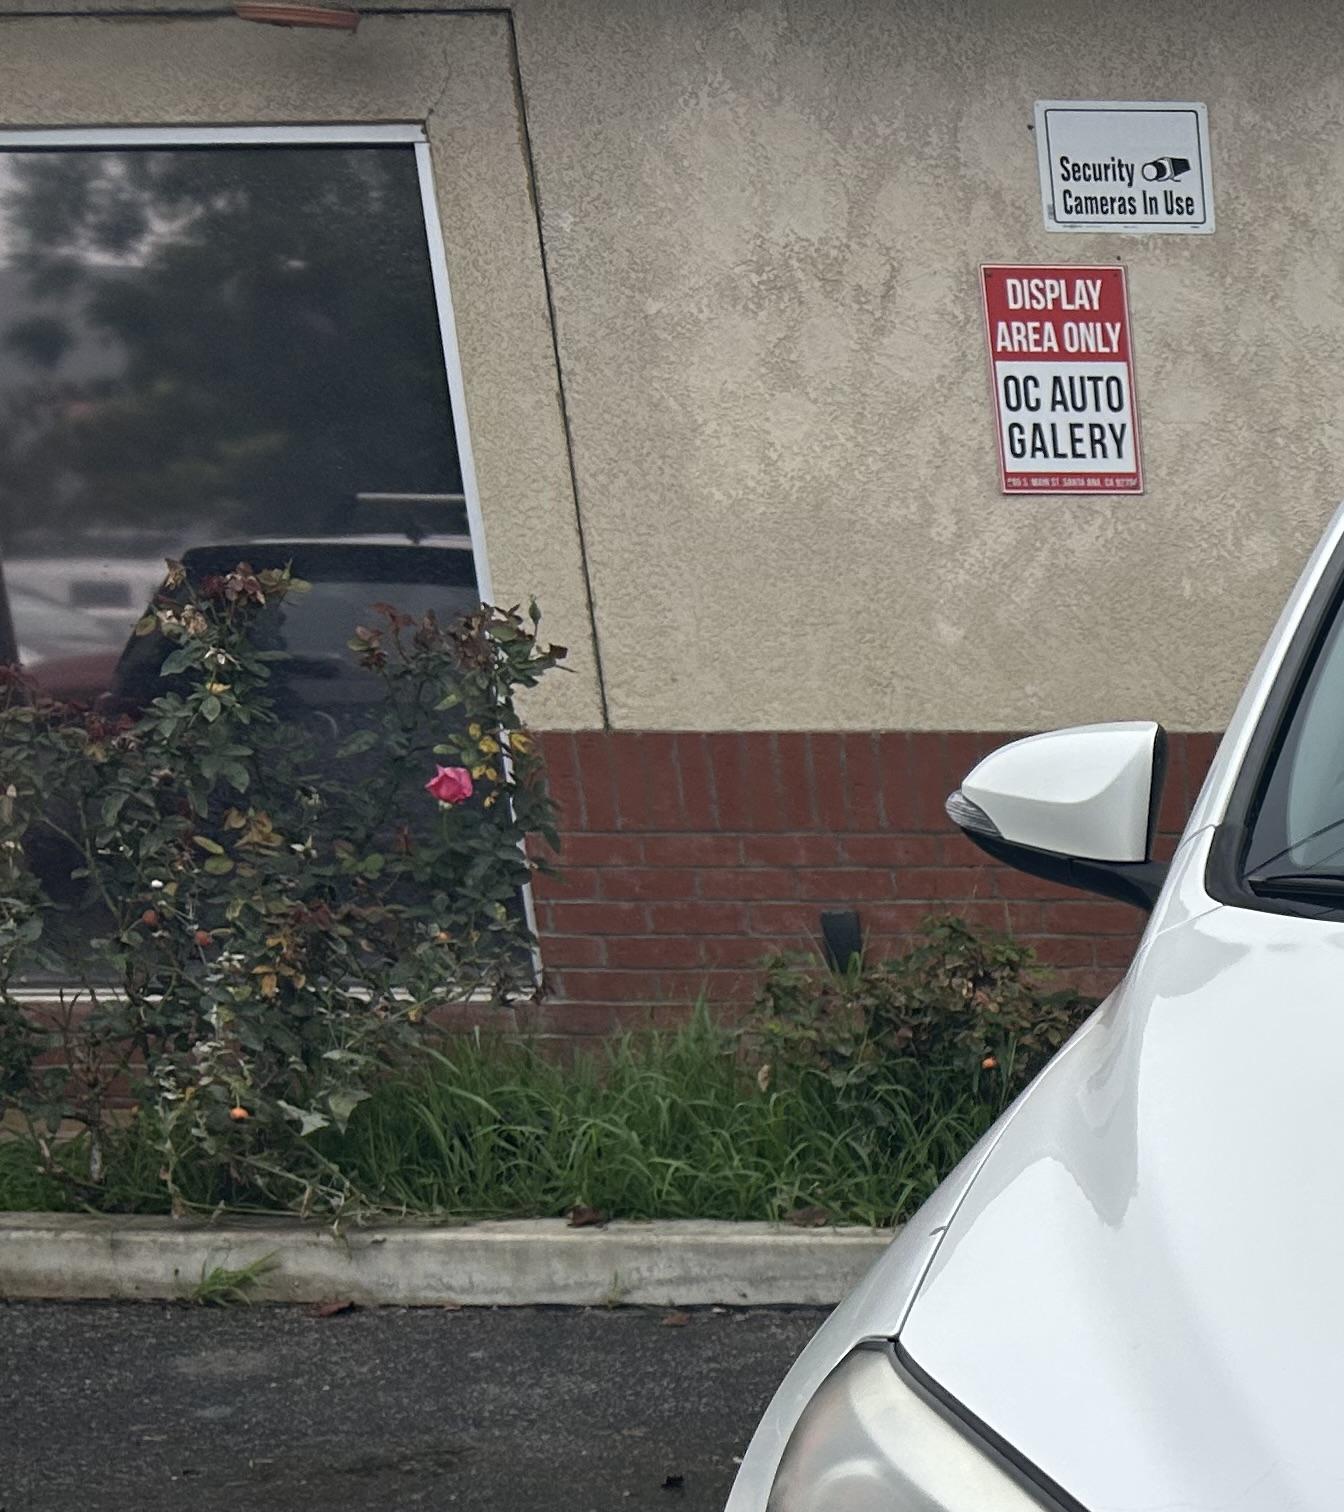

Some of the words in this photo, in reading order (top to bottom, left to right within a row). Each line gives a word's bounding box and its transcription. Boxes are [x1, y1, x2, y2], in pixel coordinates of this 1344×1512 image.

[1060, 155, 1134, 188] Security
[1063, 189, 1137, 215] Cameras
[1142, 190, 1159, 215] In
[1164, 190, 1195, 216] Use
[1006, 278, 1102, 311] DISPLAY
[996, 321, 1059, 352] AREA
[1063, 322, 1121, 353] ONLY
[1003, 375, 1041, 412] OC
[1050, 375, 1125, 412] AUTO
[1008, 422, 1127, 459] GALERY
